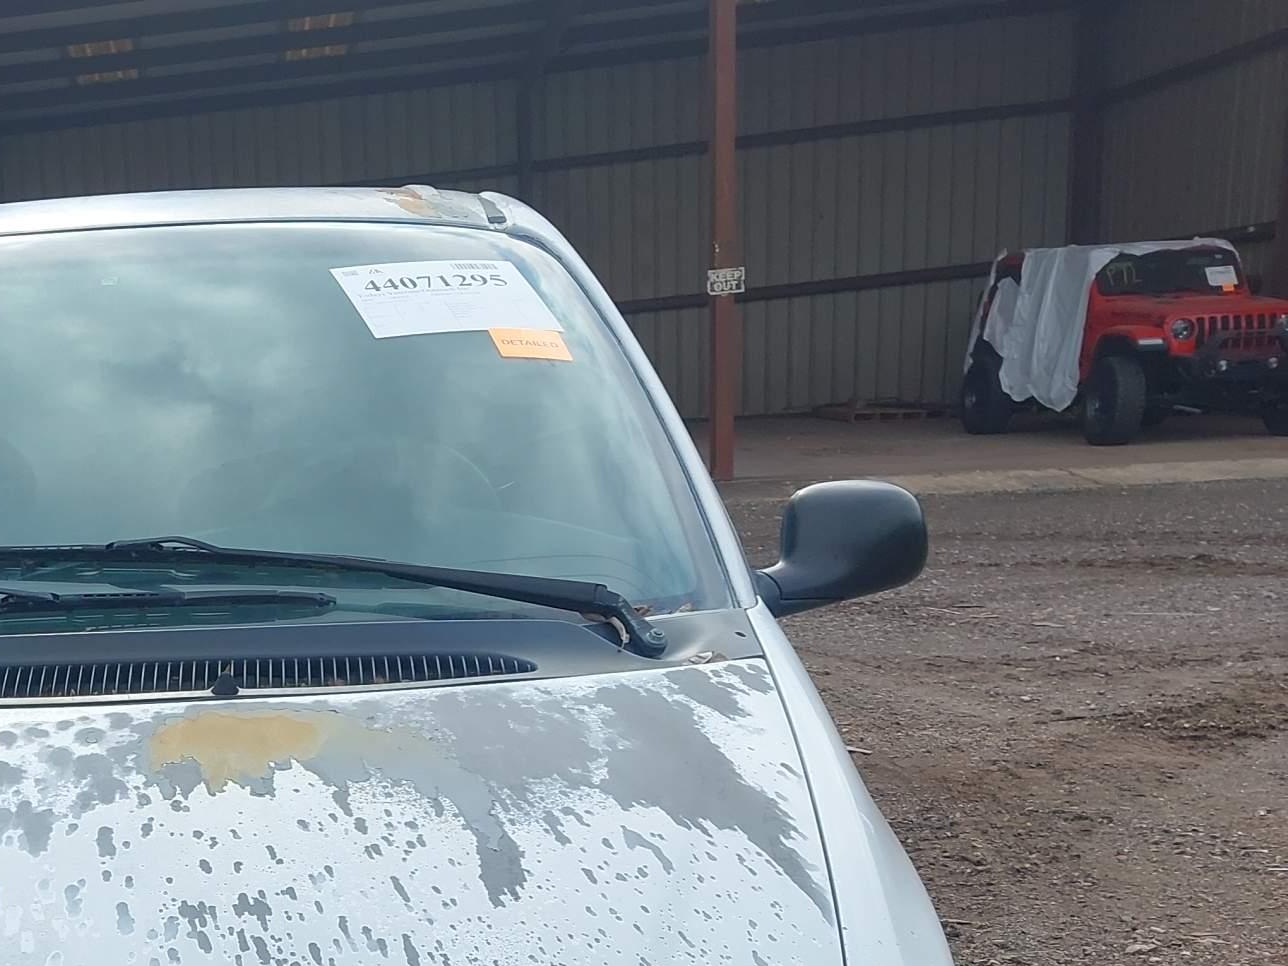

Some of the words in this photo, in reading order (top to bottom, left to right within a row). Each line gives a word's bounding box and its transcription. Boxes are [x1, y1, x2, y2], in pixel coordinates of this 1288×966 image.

[712, 271, 741, 281] KEEP
[364, 273, 508, 292] 44071295
[713, 281, 738, 292] OUT
[501, 338, 560, 348] DETAILED
